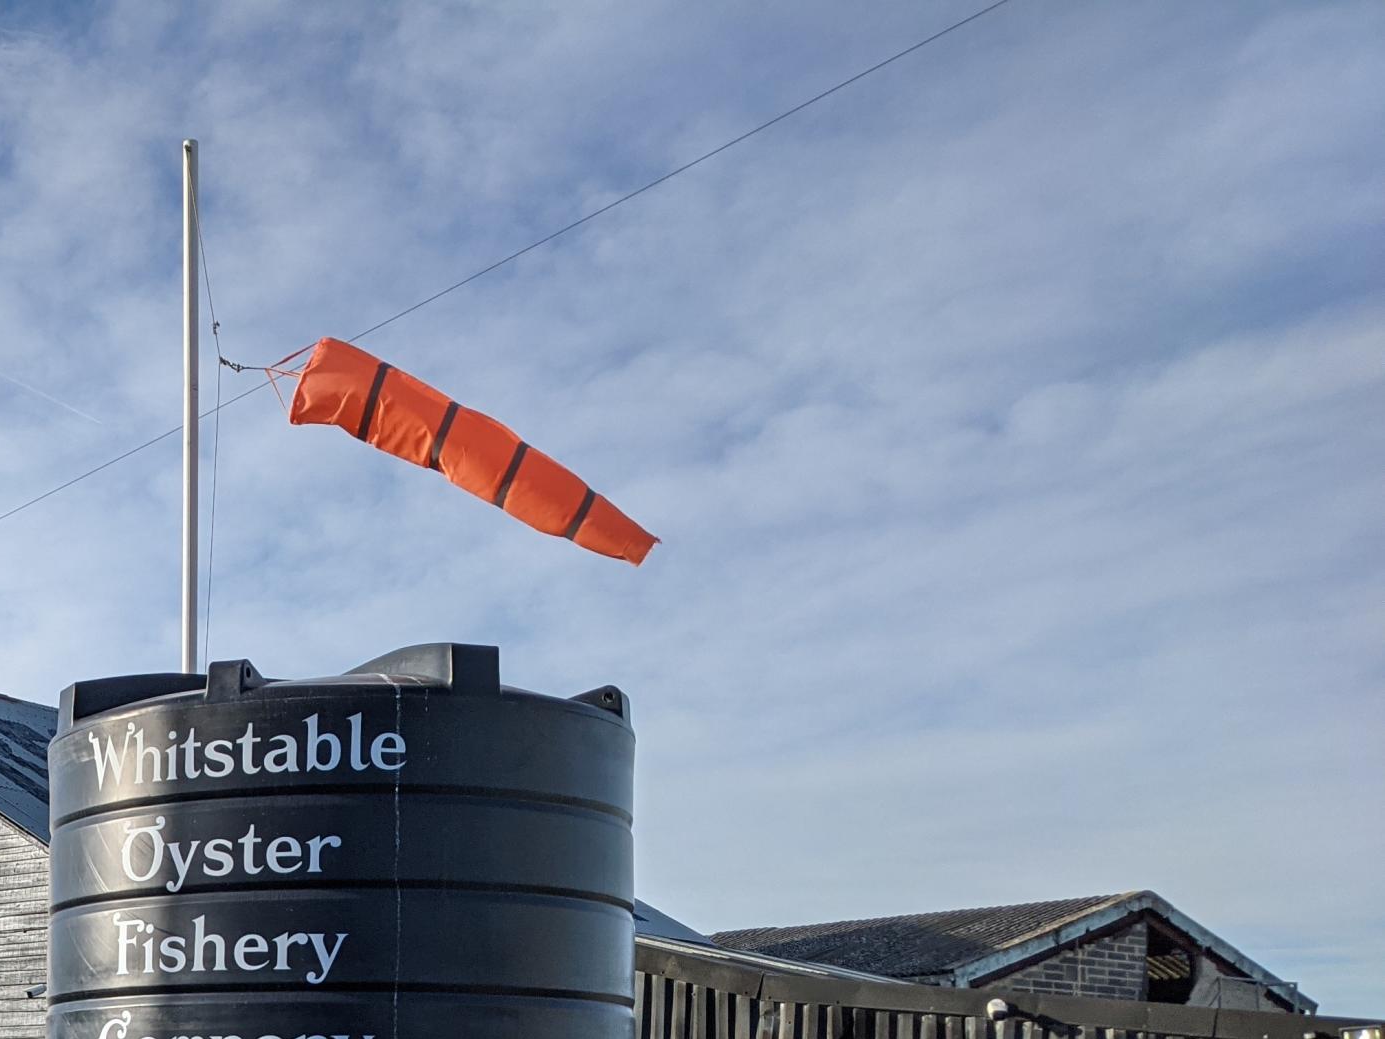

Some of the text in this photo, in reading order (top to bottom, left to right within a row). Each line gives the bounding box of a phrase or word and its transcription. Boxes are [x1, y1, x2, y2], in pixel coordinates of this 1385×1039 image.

[89, 711, 407, 792] Whitstable
[121, 815, 341, 893] Oyster
[112, 912, 349, 985] Fishery
